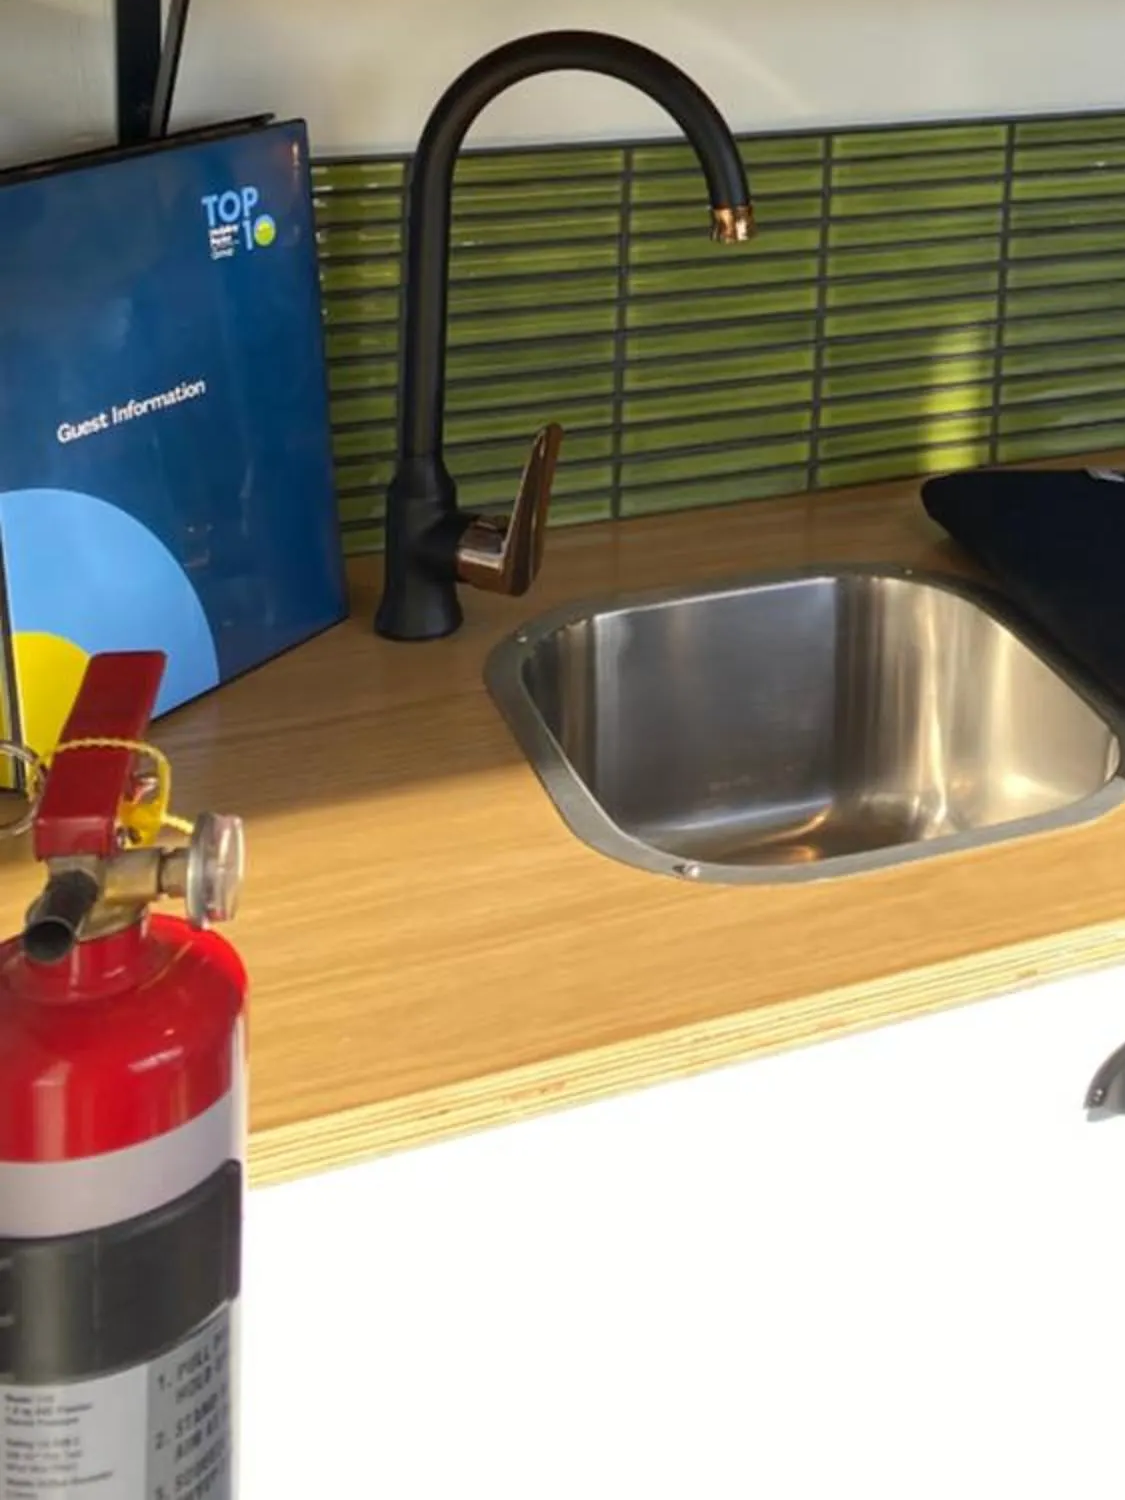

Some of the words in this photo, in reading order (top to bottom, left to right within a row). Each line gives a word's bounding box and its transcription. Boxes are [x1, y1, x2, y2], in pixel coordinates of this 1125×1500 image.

[201, 186, 258, 228] TOP
[56, 411, 109, 445] Guest
[111, 379, 207, 425] Information
